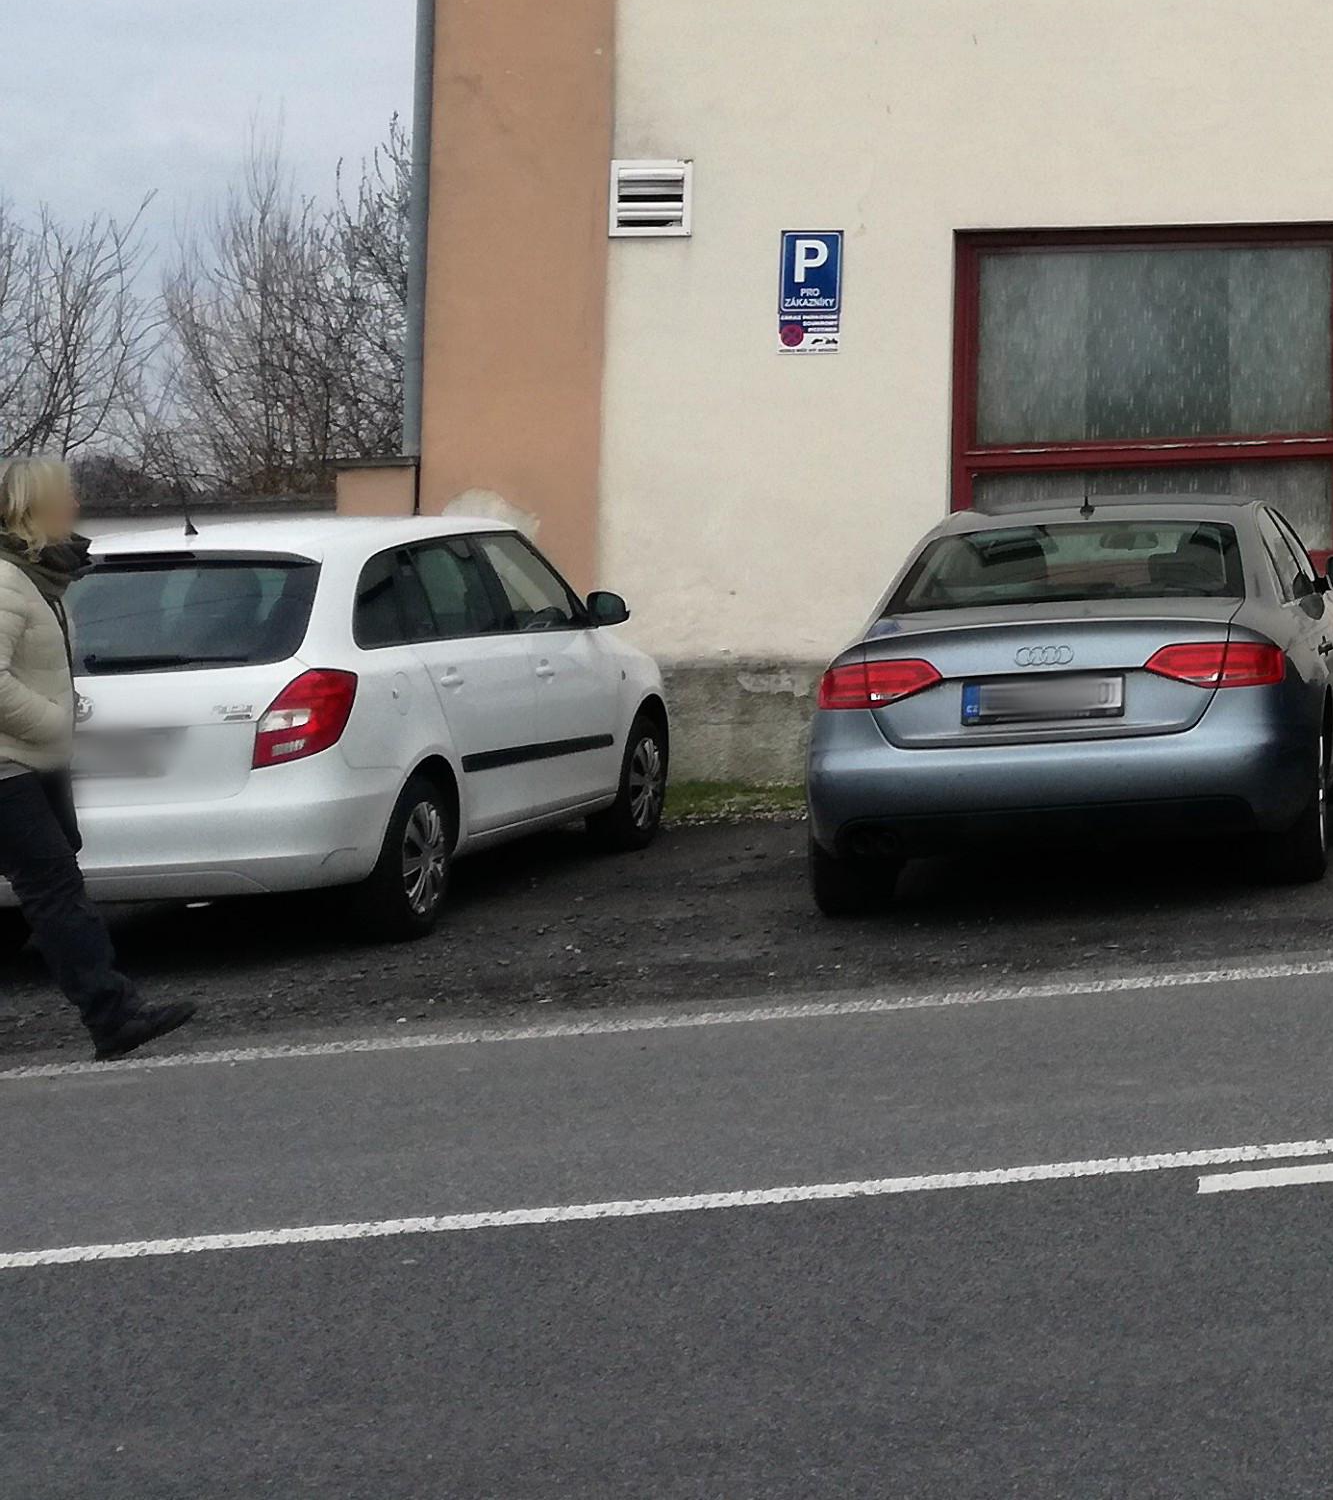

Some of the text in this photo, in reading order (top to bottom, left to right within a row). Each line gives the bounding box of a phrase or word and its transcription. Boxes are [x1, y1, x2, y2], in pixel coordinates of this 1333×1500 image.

[794, 239, 829, 283] P
[800, 287, 820, 298] PRO
[784, 296, 836, 307] ZÁKAZNÍKY
[966, 704, 979, 713] CZ
